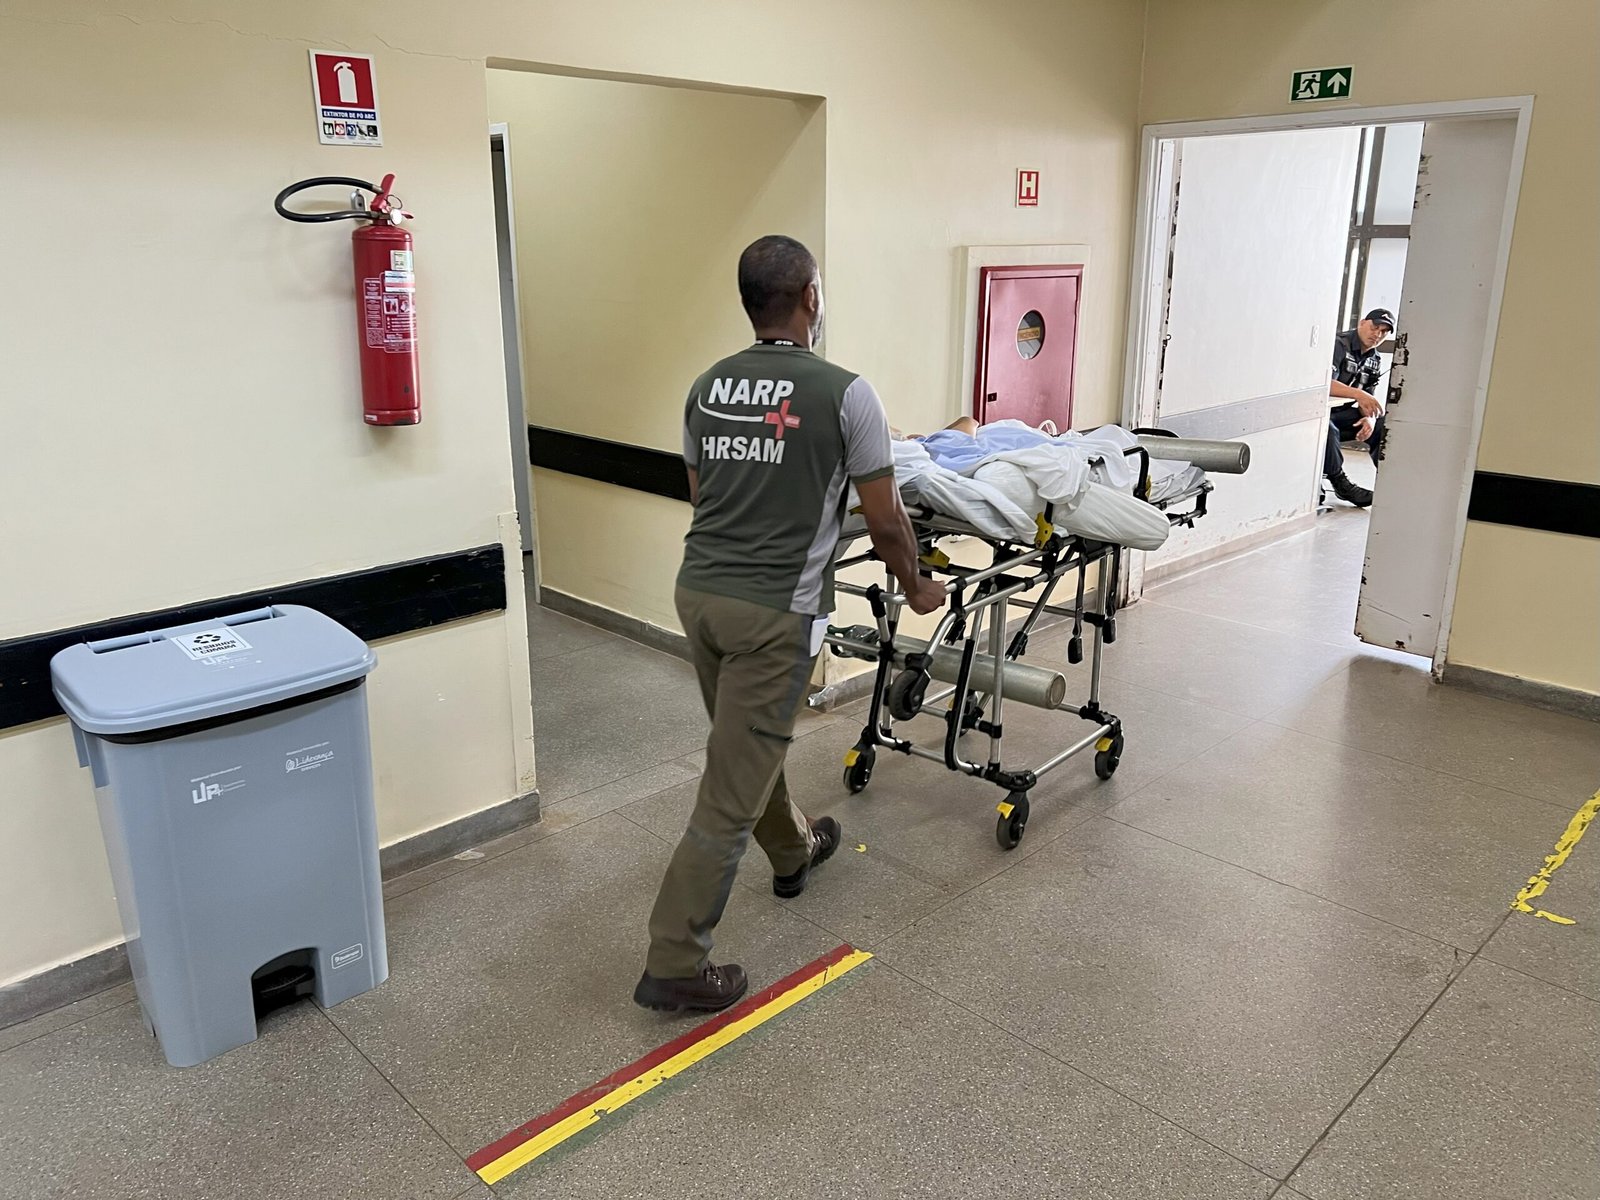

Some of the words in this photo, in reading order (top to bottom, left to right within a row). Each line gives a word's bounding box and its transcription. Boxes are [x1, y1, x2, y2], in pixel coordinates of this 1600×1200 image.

[1021, 173, 1037, 197] H
[707, 377, 795, 406] NARP
[701, 436, 786, 464] HRSAM
[199, 643, 237, 655] COMUM
